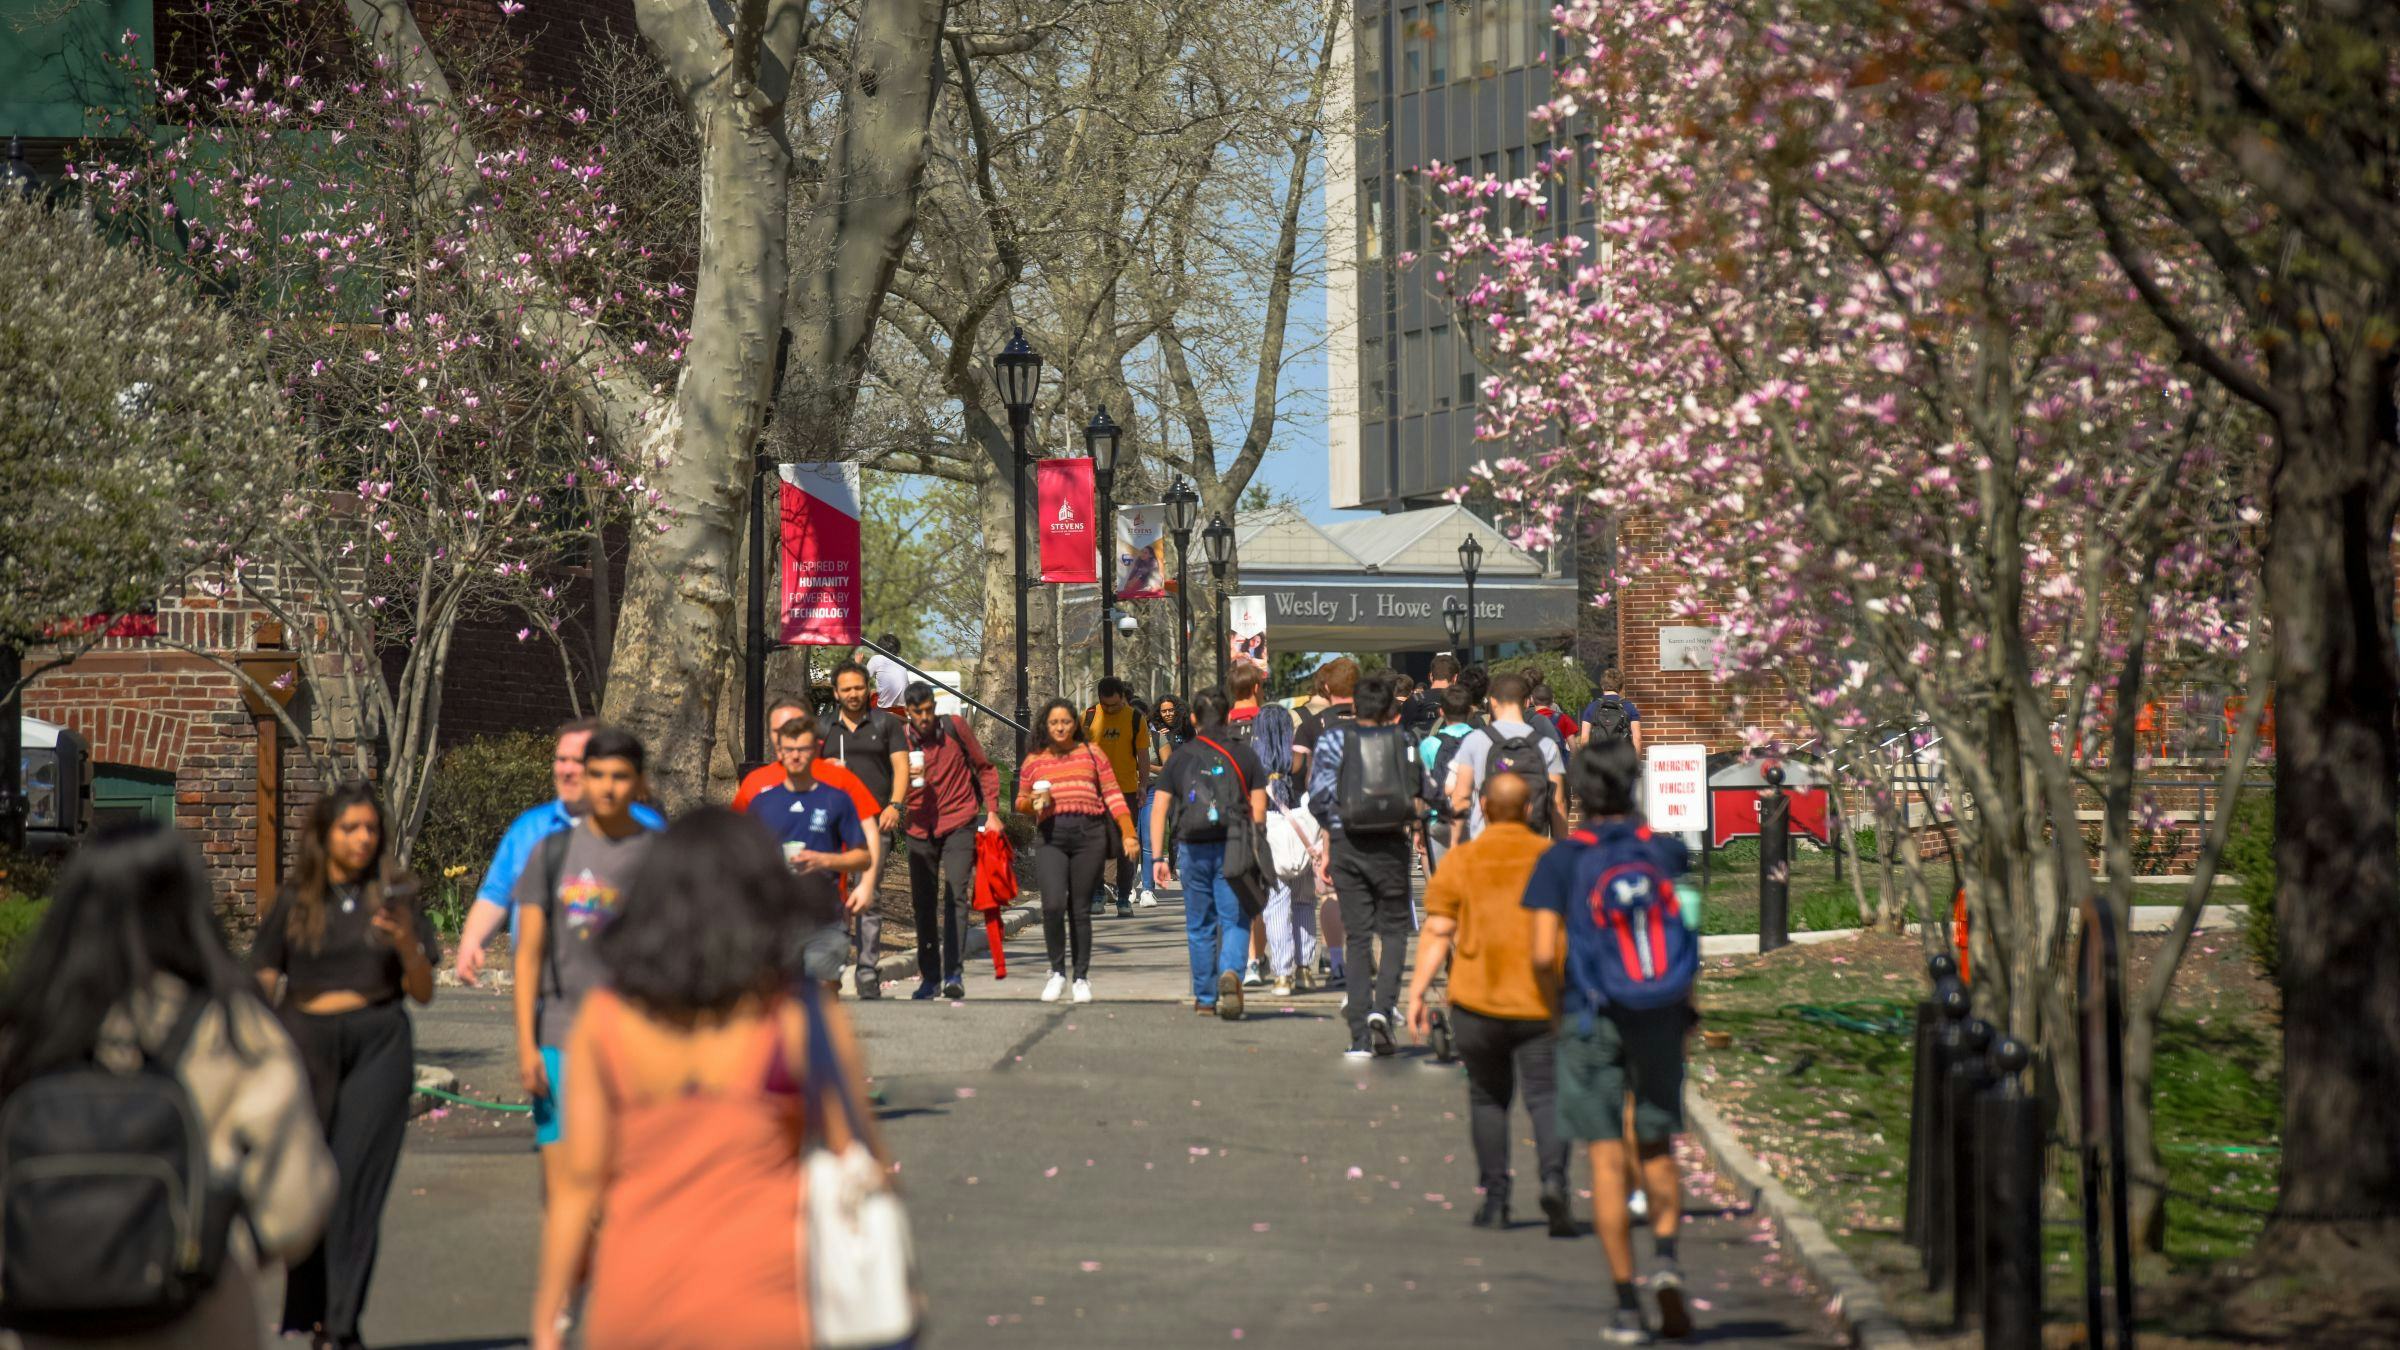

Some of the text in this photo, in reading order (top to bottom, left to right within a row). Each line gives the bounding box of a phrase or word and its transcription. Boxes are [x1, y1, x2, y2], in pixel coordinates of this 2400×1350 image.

[1050, 522, 1084, 530] STEVENS
[792, 561, 849, 572] INSPIRED BY
[799, 576, 849, 588] HUMANITY
[789, 592, 849, 603] POWERED BY
[789, 607, 849, 618] TECHNOLOGY
[1273, 591, 1339, 622] Wesley
[1348, 593, 1364, 622] J.
[1376, 593, 1431, 618] Howe
[1654, 760, 1700, 772] EMERGENCY
[1659, 782, 1696, 794] VEHICLES
[1668, 804, 1687, 816] ONLY
